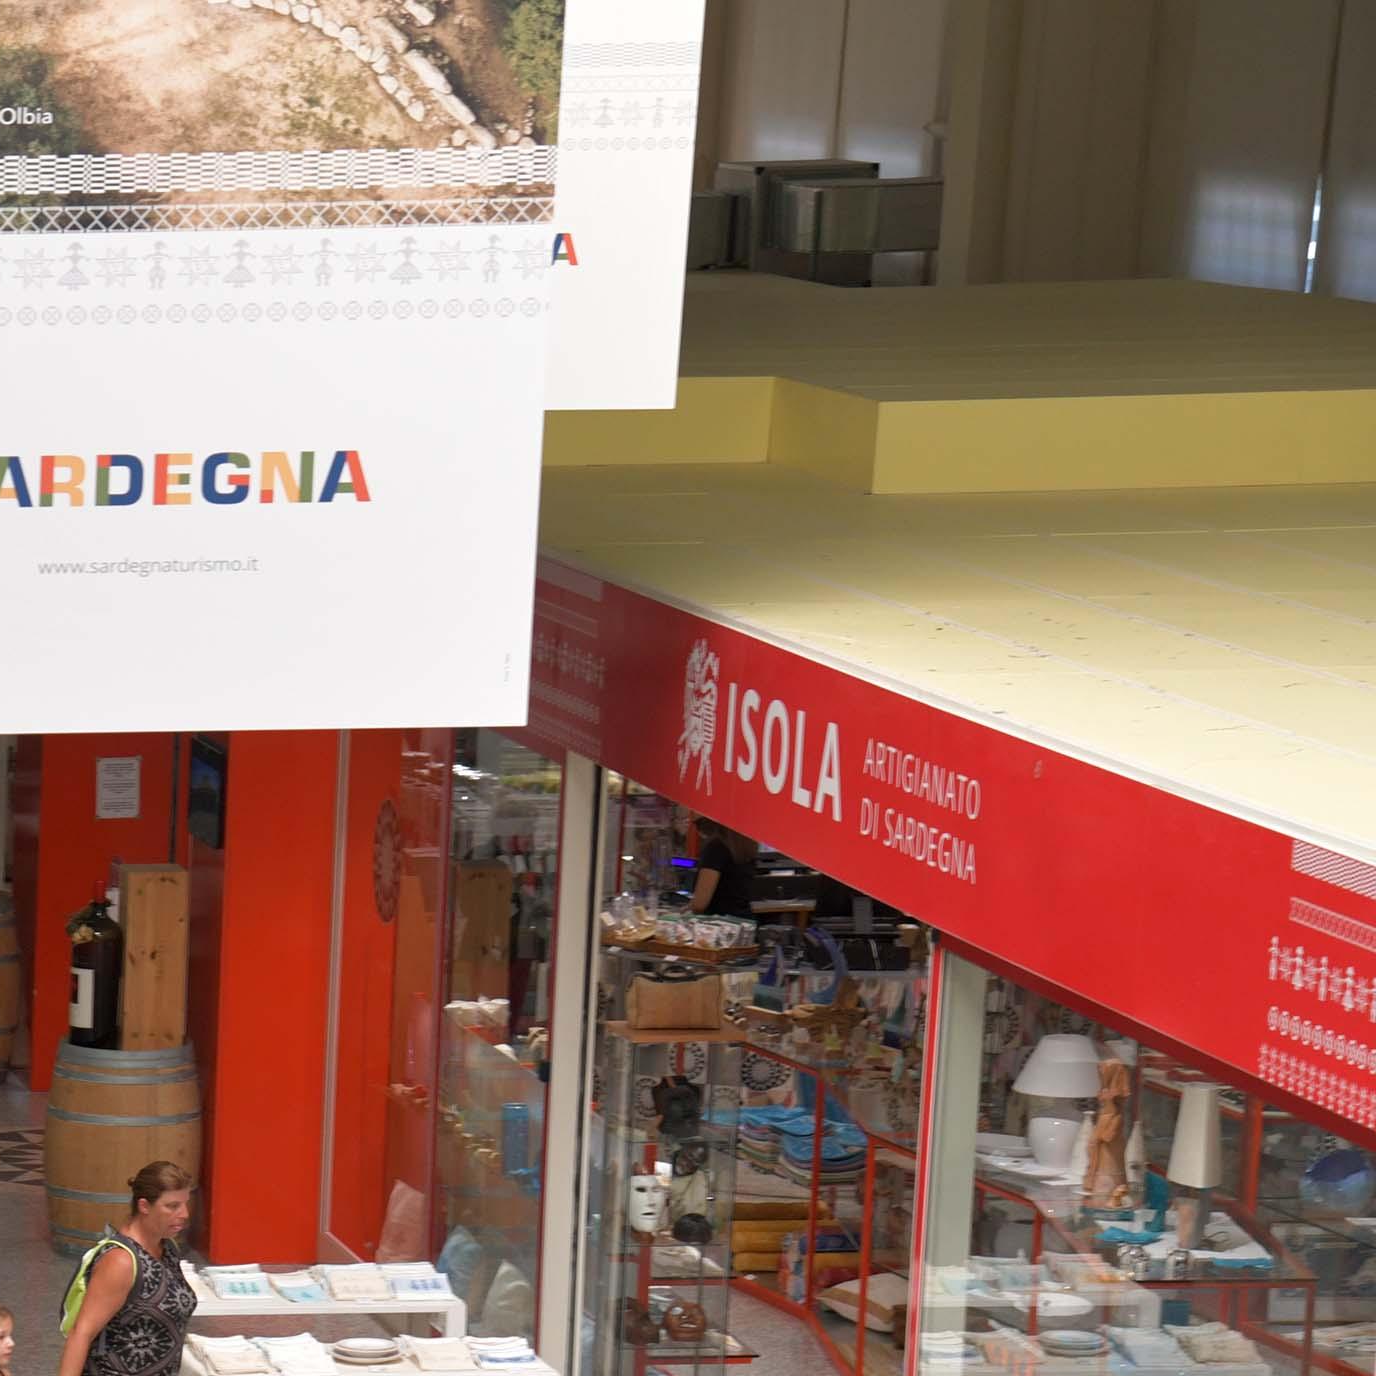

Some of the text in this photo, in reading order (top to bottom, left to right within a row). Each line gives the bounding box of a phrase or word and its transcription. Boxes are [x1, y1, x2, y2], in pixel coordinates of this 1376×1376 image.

[38, 556, 261, 578] www.sardegnaturismo.it
[723, 682, 842, 823] ISOLA
[862, 737, 982, 820] ARTIGIANATO
[859, 796, 977, 885] DI SARDEGNA
